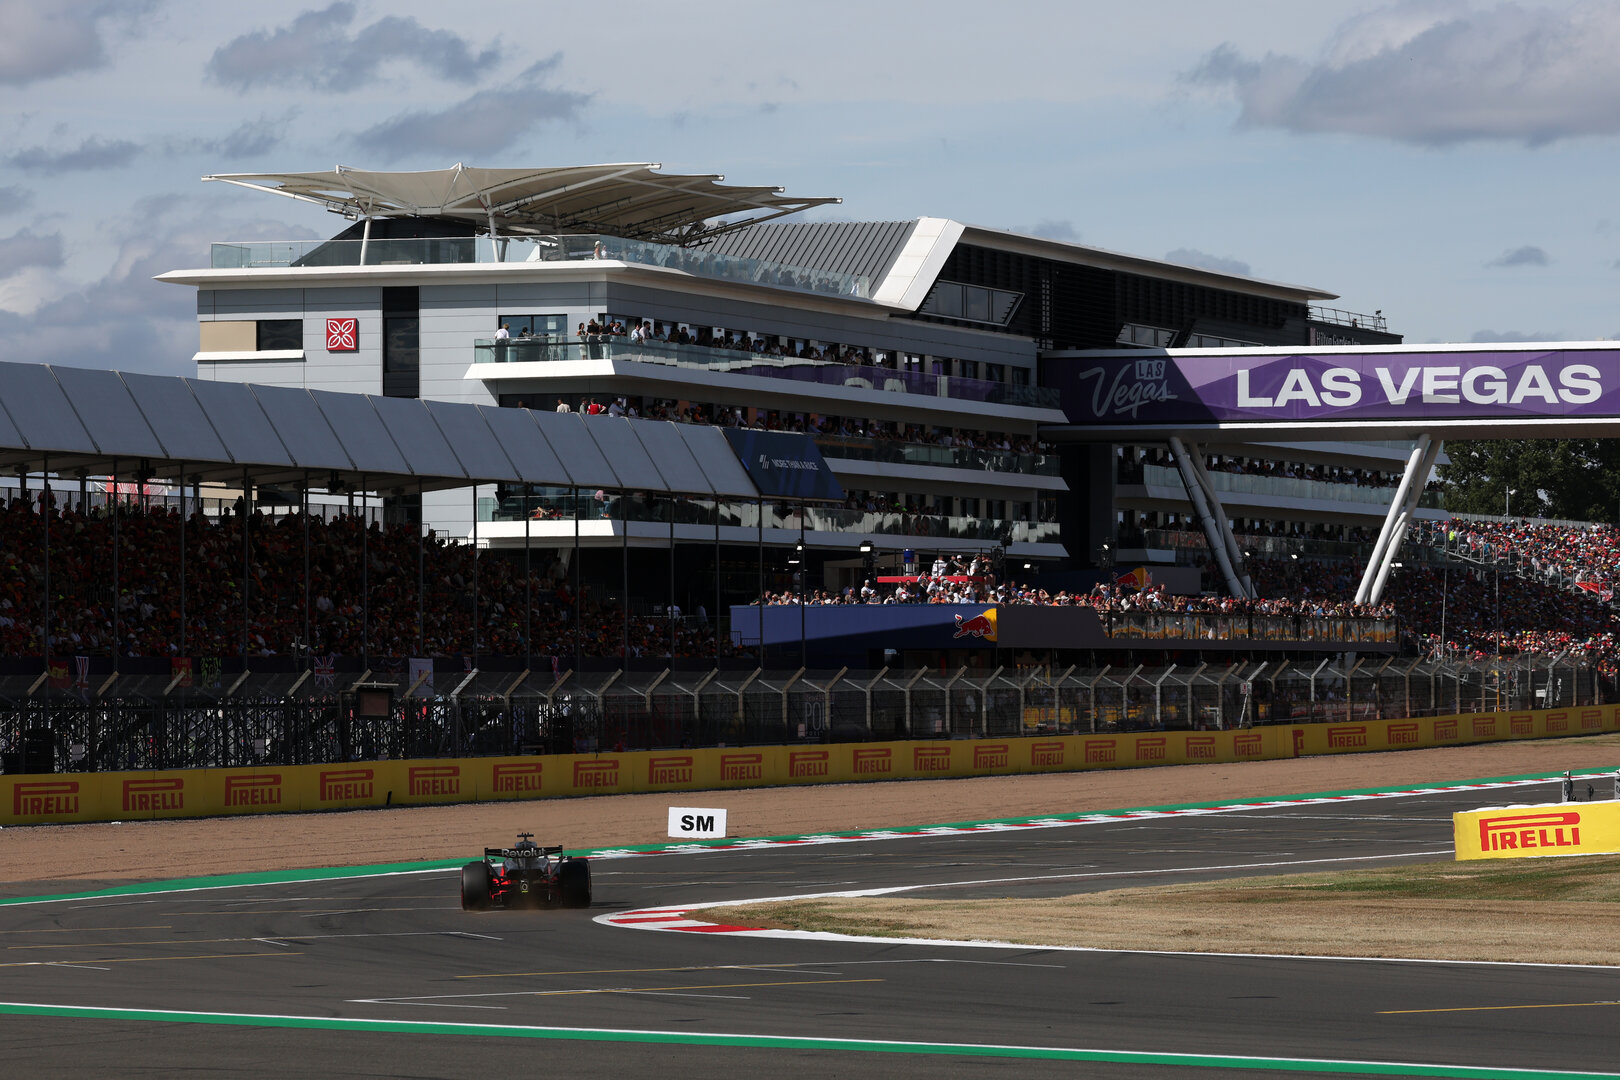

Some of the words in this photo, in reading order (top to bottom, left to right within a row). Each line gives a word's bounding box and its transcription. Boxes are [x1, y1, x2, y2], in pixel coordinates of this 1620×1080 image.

[1136, 360, 1166, 380] LAS
[1079, 363, 1178, 419] Vegas
[1237, 367, 1362, 408] LAS
[1375, 364, 1602, 406] VEGAS
[1233, 735, 1262, 756] PIRELLI
[1327, 726, 1367, 748] PIRELLI
[1388, 723, 1419, 745] PIRELLI
[914, 746, 951, 771] PIRELLI
[974, 745, 1009, 768] PIRELLI
[1032, 742, 1065, 766] PIRELLI
[1085, 740, 1117, 763] PIRELLI
[1136, 738, 1167, 761] PIRELLI
[1186, 737, 1216, 758] PIRELLI
[574, 760, 619, 788] PIRELLI
[649, 757, 693, 784] PIRELLI
[721, 754, 762, 781] PIRELLI
[789, 751, 829, 778] PIRELLI
[853, 748, 892, 774] PIRELLI
[224, 774, 282, 807] PIRELLI
[319, 769, 375, 801] PIRELLI
[409, 766, 460, 796] PIRELLI
[493, 763, 542, 793] PIRELLI
[13, 781, 80, 816] PIRELLI
[122, 778, 184, 811] PIRELLI
[680, 814, 715, 832] SM
[1478, 811, 1581, 852] PIRELLI
[501, 847, 546, 858] Revolut
